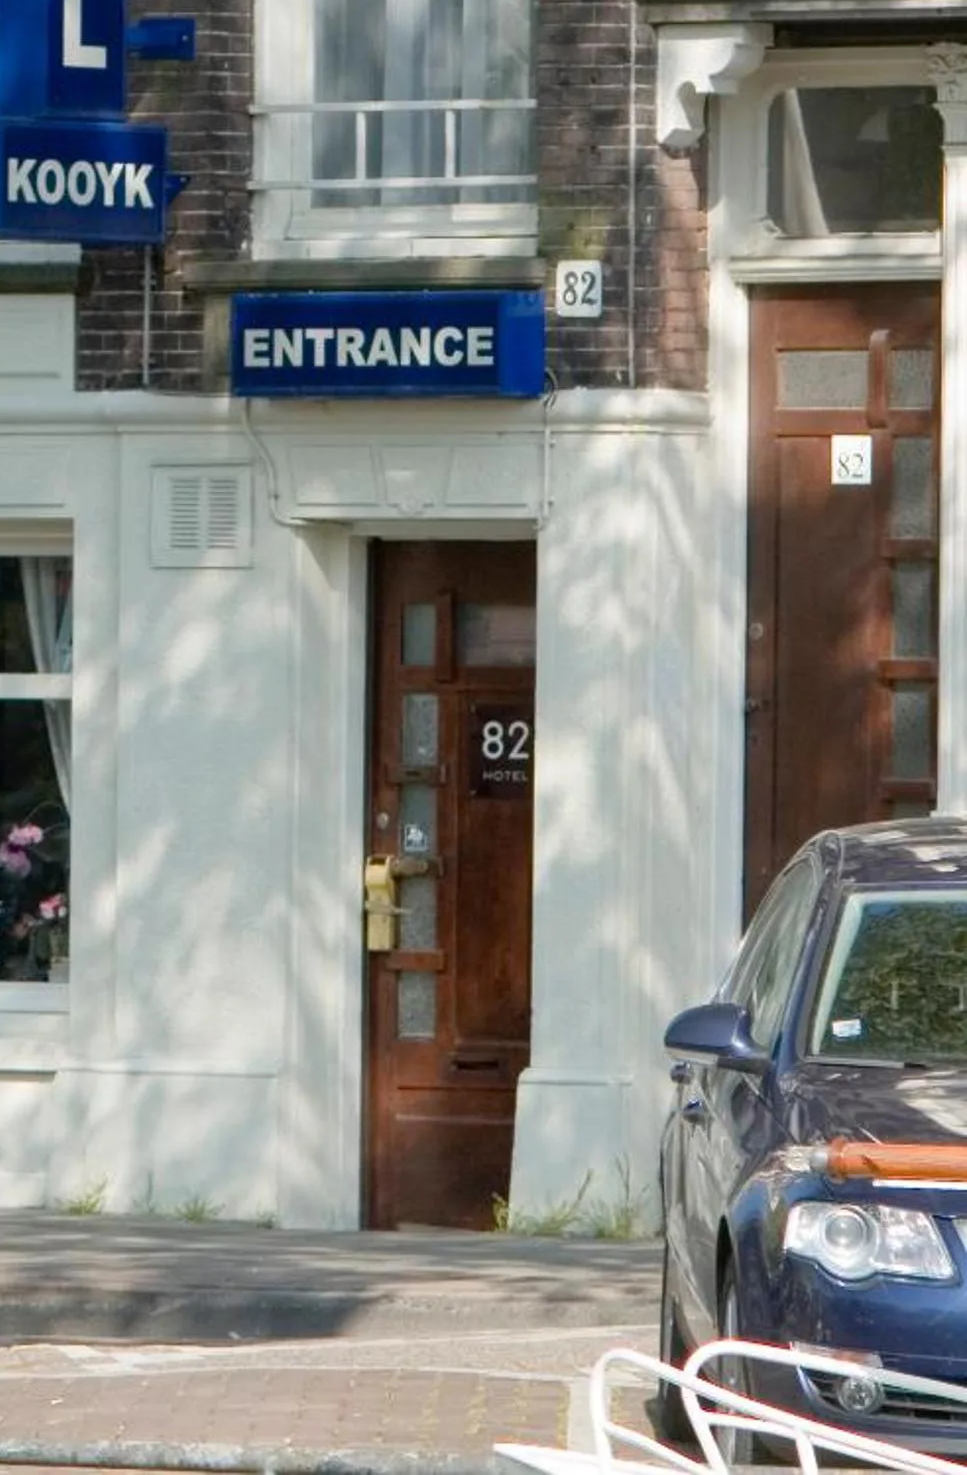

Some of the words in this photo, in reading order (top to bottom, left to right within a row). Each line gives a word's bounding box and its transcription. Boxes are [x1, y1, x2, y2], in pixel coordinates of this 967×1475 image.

[6, 157, 155, 208] KOOYK
[563, 271, 598, 306] 82
[242, 326, 495, 368] ENTRANCE
[838, 452, 864, 479] 82
[482, 720, 530, 760] 82
[482, 770, 529, 782] HOTEL
